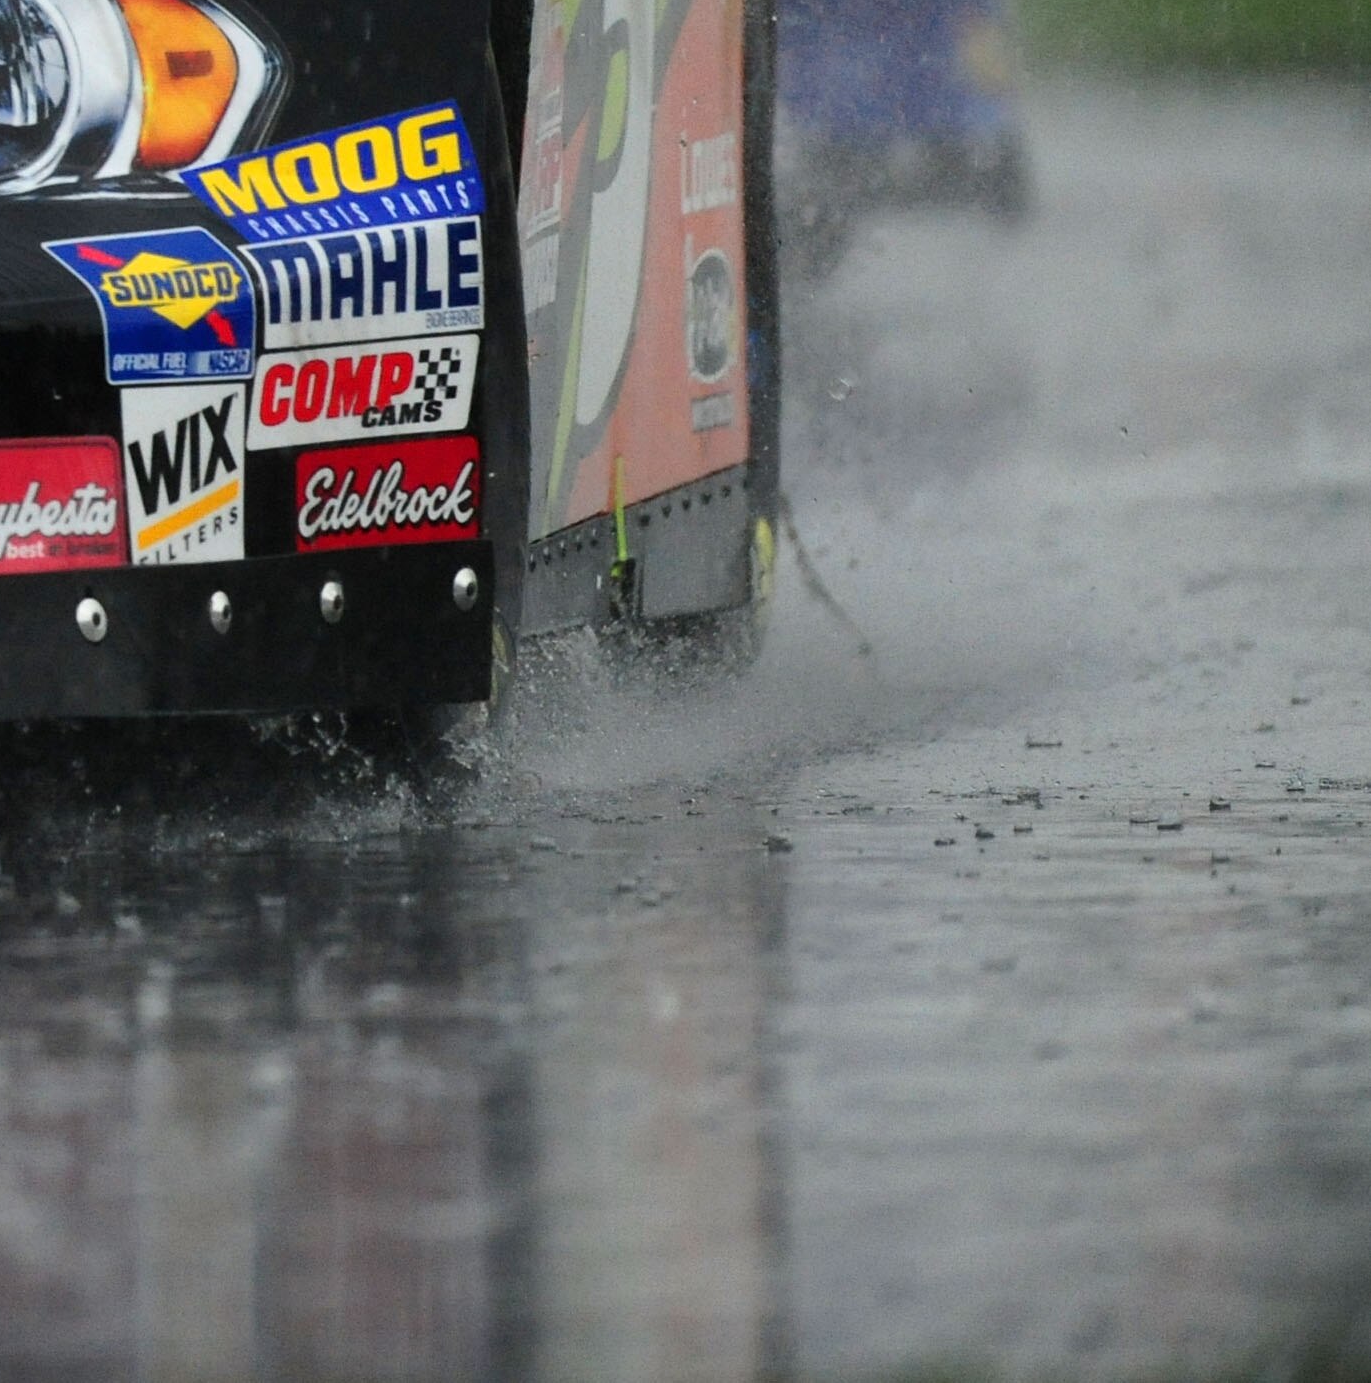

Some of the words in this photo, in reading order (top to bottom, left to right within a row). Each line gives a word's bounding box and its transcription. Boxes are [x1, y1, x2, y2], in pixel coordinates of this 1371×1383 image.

[199, 108, 462, 216] MOOG
[248, 202, 370, 240] CHASSIS
[381, 180, 471, 219] PARTS
[110, 266, 233, 302] SUNOCO
[248, 221, 480, 325] MAHLE
[113, 353, 159, 372] OFFICIAL
[162, 351, 187, 370] FUEL
[259, 351, 415, 428] COMP
[361, 400, 443, 429] CAMS
[128, 392, 239, 517] WIX
[297, 460, 475, 539] Edelbrock
[6, 540, 46, 559] best
[139, 507, 239, 566] FILTERS
